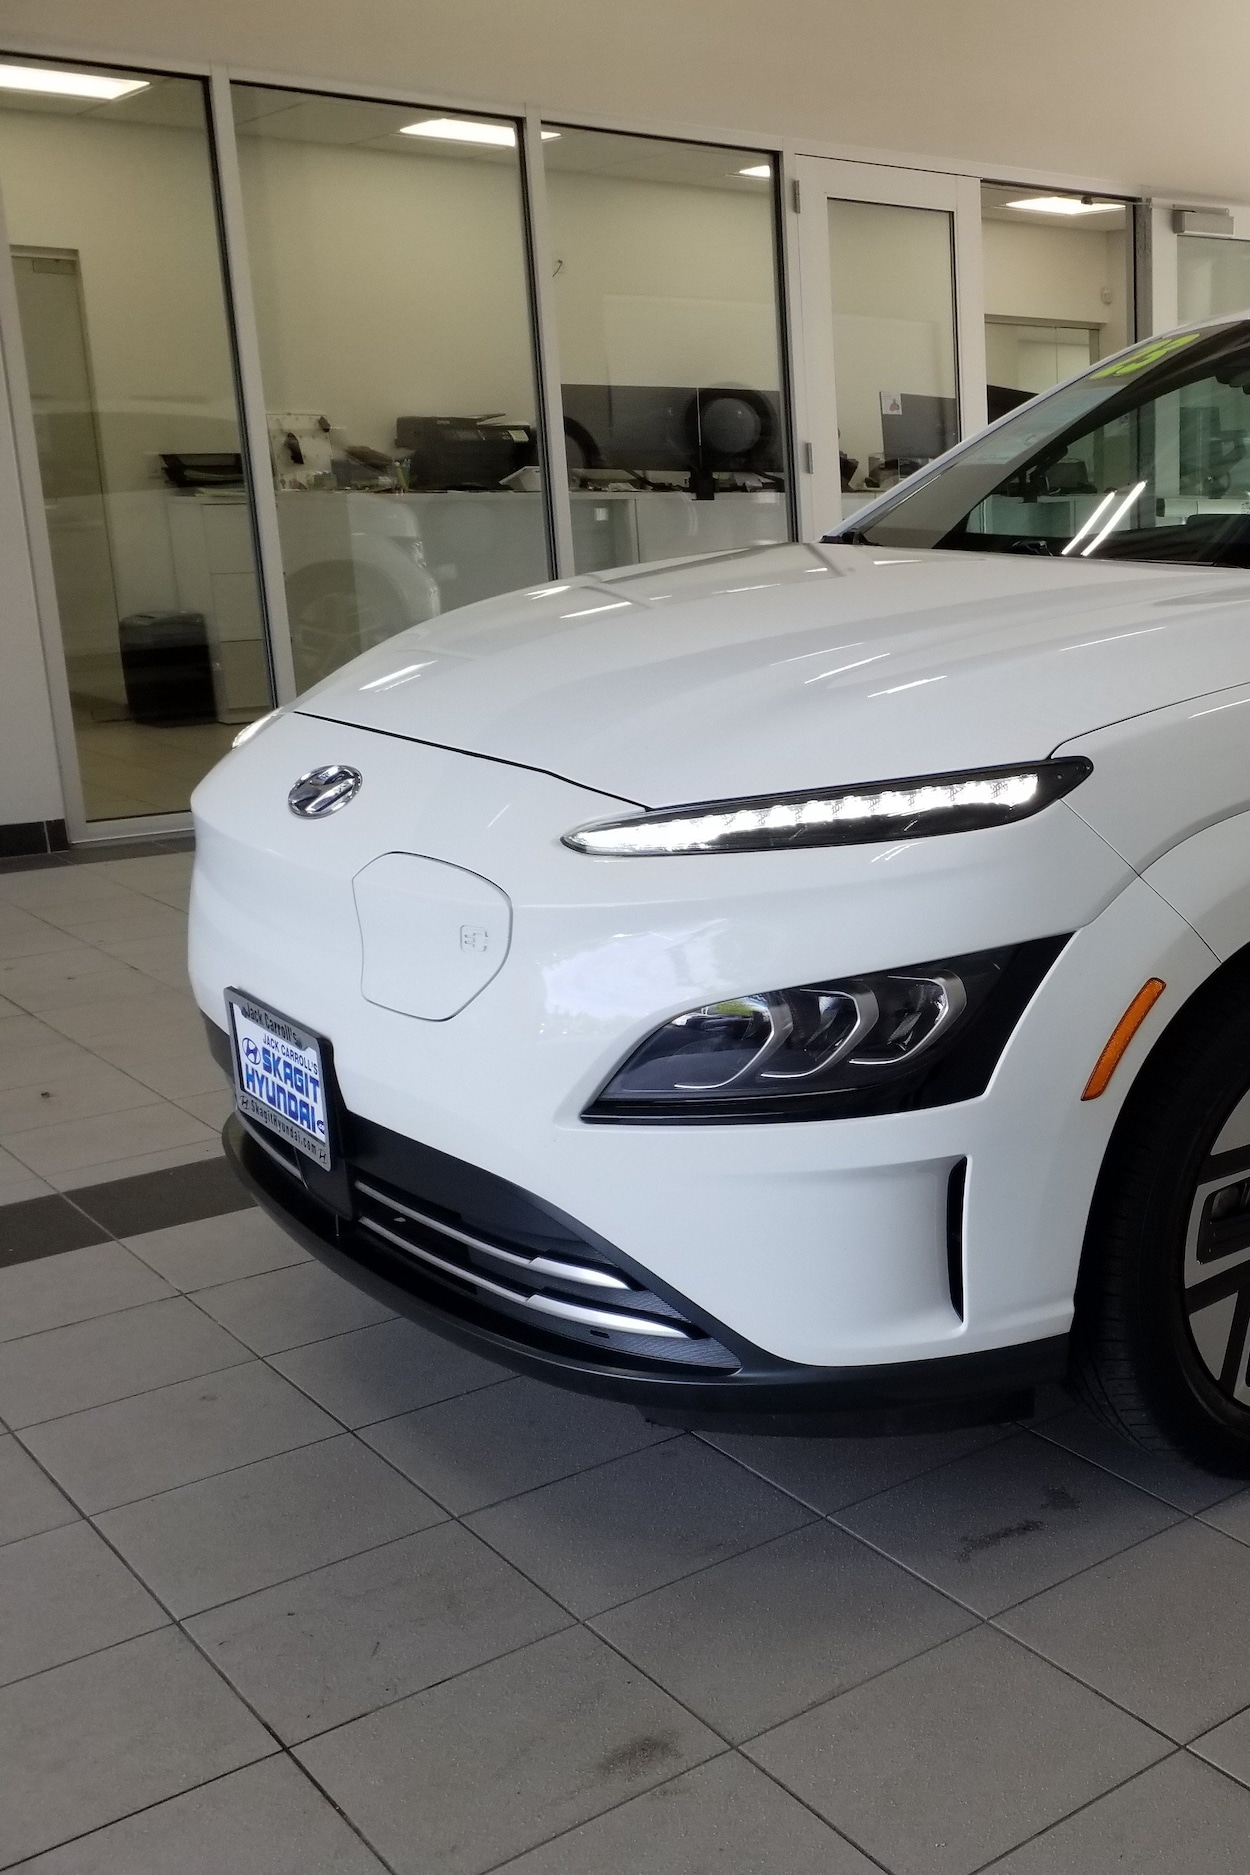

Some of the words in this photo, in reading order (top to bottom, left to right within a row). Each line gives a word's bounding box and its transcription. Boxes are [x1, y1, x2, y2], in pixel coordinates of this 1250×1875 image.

[245, 1003, 264, 1026] Jack
[264, 1012, 298, 1042] Carroll's
[261, 1047, 320, 1105] SKAGIT
[263, 1033, 280, 1053] JACK
[280, 1044, 319, 1076] CARROLL'S
[244, 1062, 317, 1134] HYUNDAI
[250, 1099, 318, 1156] SkagitHyundai.com
